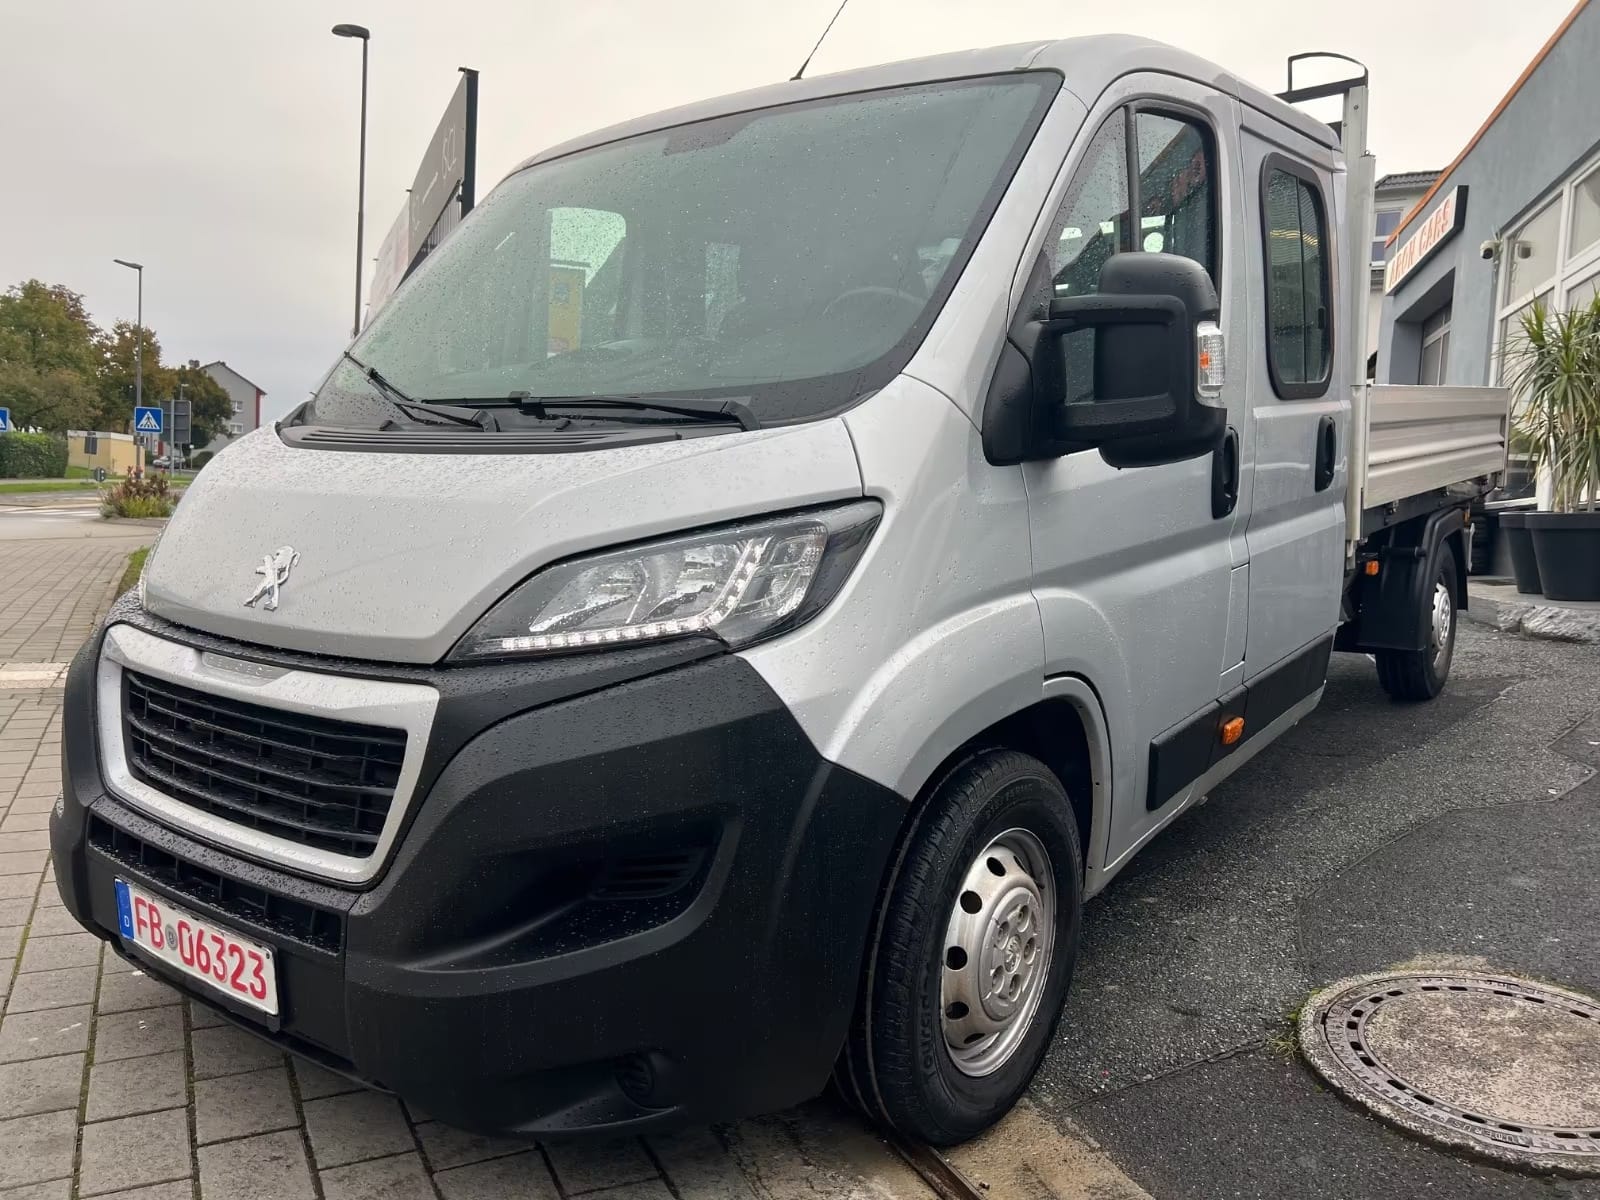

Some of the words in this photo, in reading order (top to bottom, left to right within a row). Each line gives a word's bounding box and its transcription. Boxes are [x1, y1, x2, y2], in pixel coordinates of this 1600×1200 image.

[124, 915, 130, 928] D
[134, 896, 165, 950] FB
[177, 919, 268, 1000] 06323
